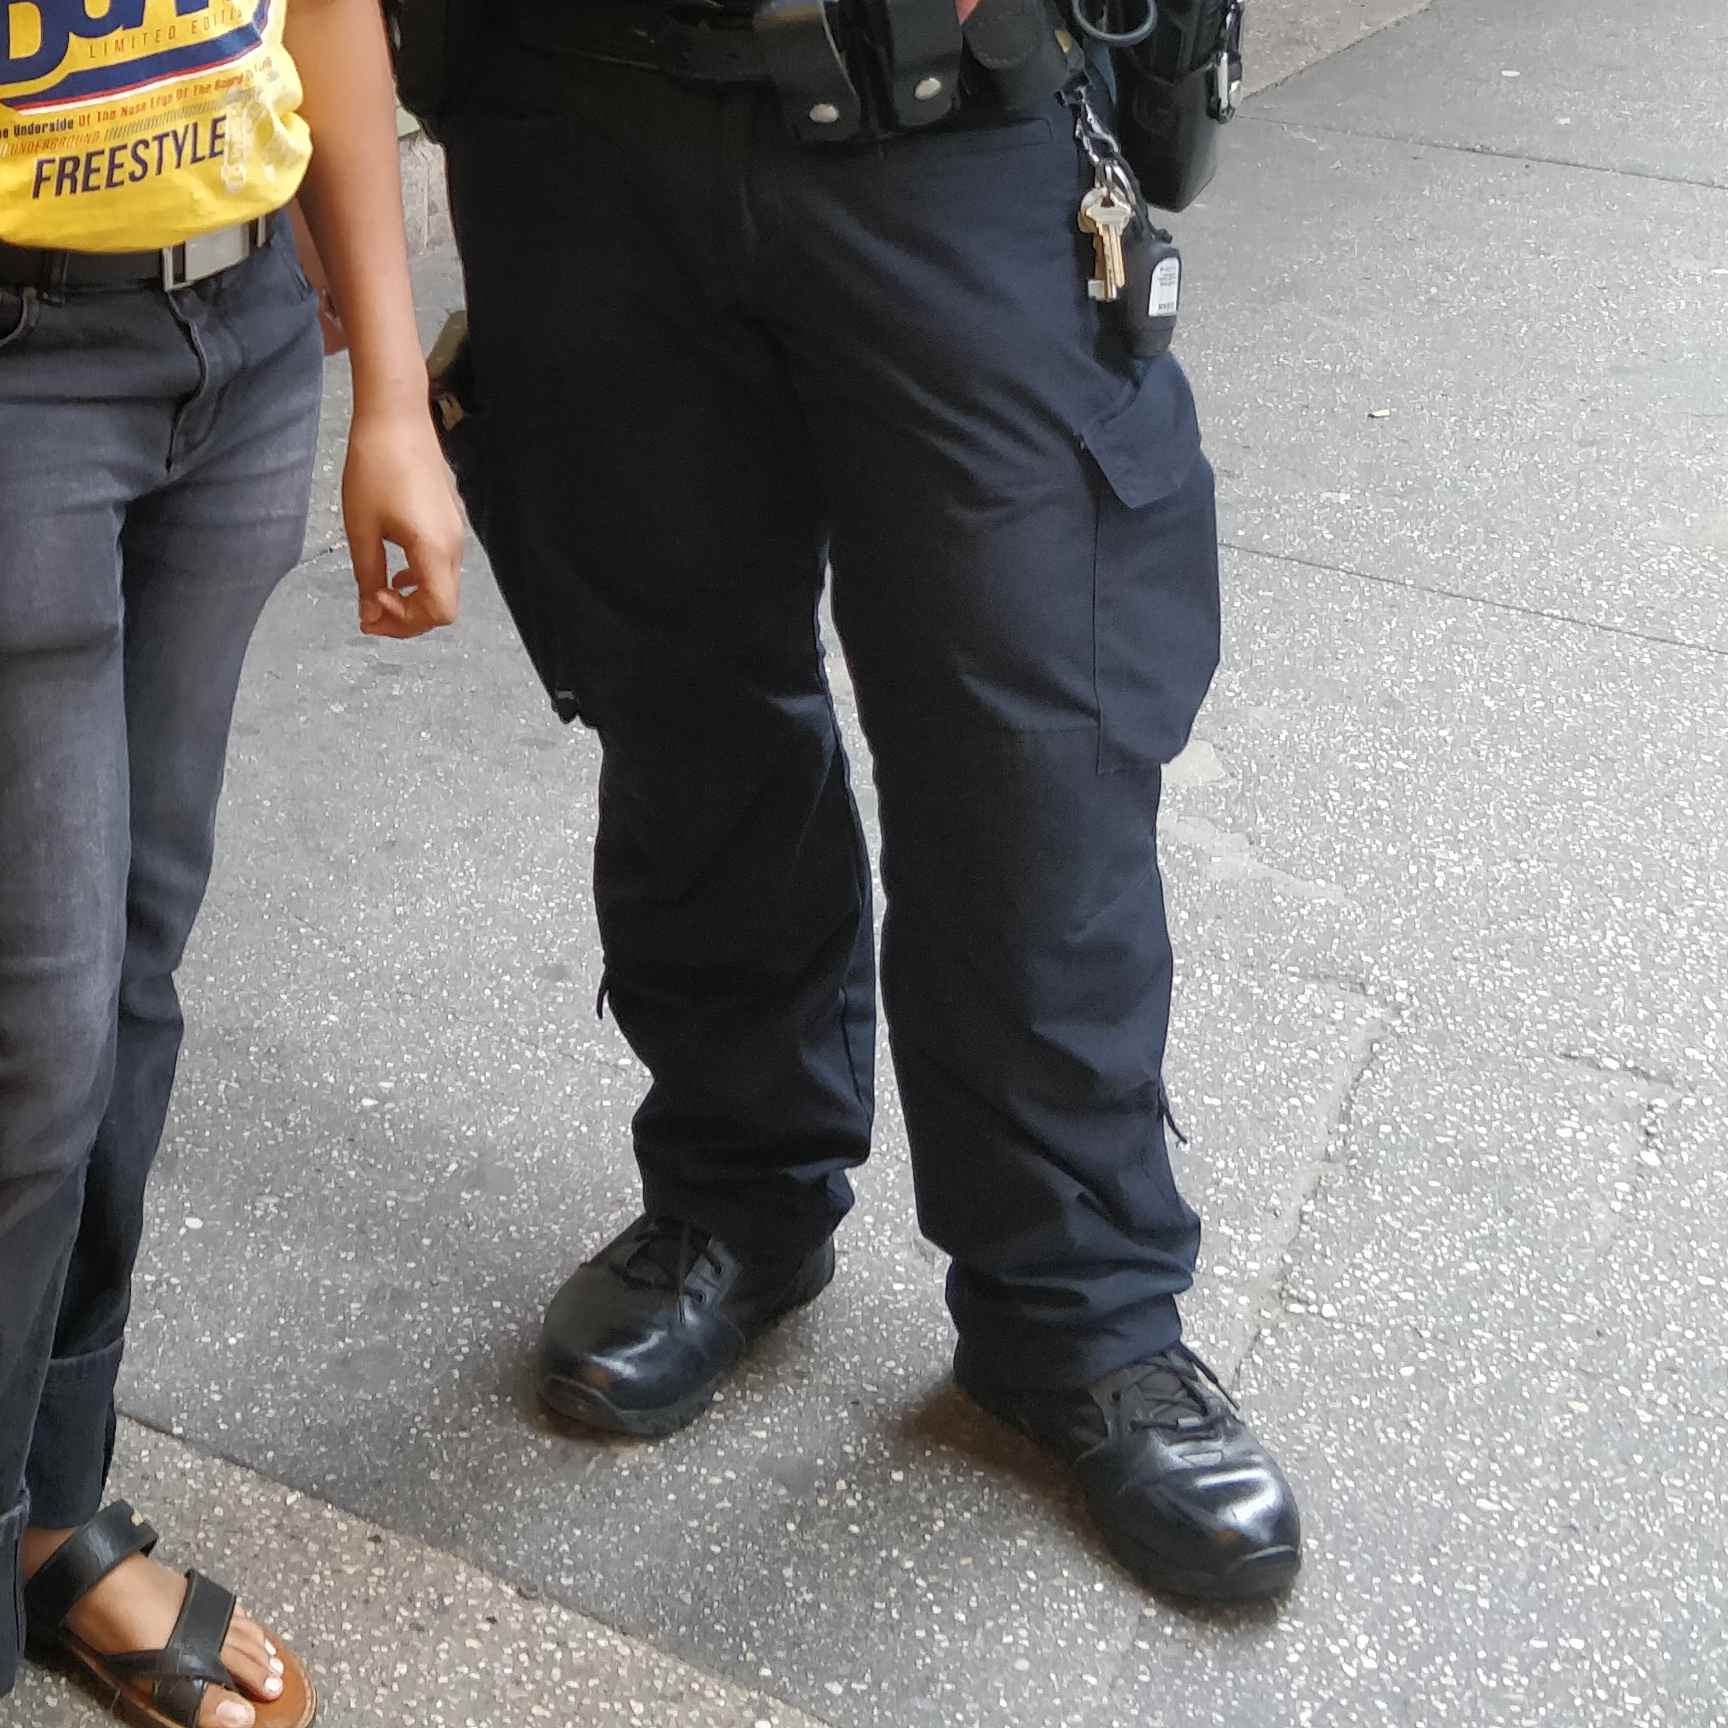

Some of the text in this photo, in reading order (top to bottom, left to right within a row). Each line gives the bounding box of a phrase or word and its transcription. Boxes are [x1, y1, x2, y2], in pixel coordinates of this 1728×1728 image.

[87, 23, 177, 59] LIMITED
[13, 119, 74, 138] Underside
[32, 113, 228, 200] FREESTYLE
